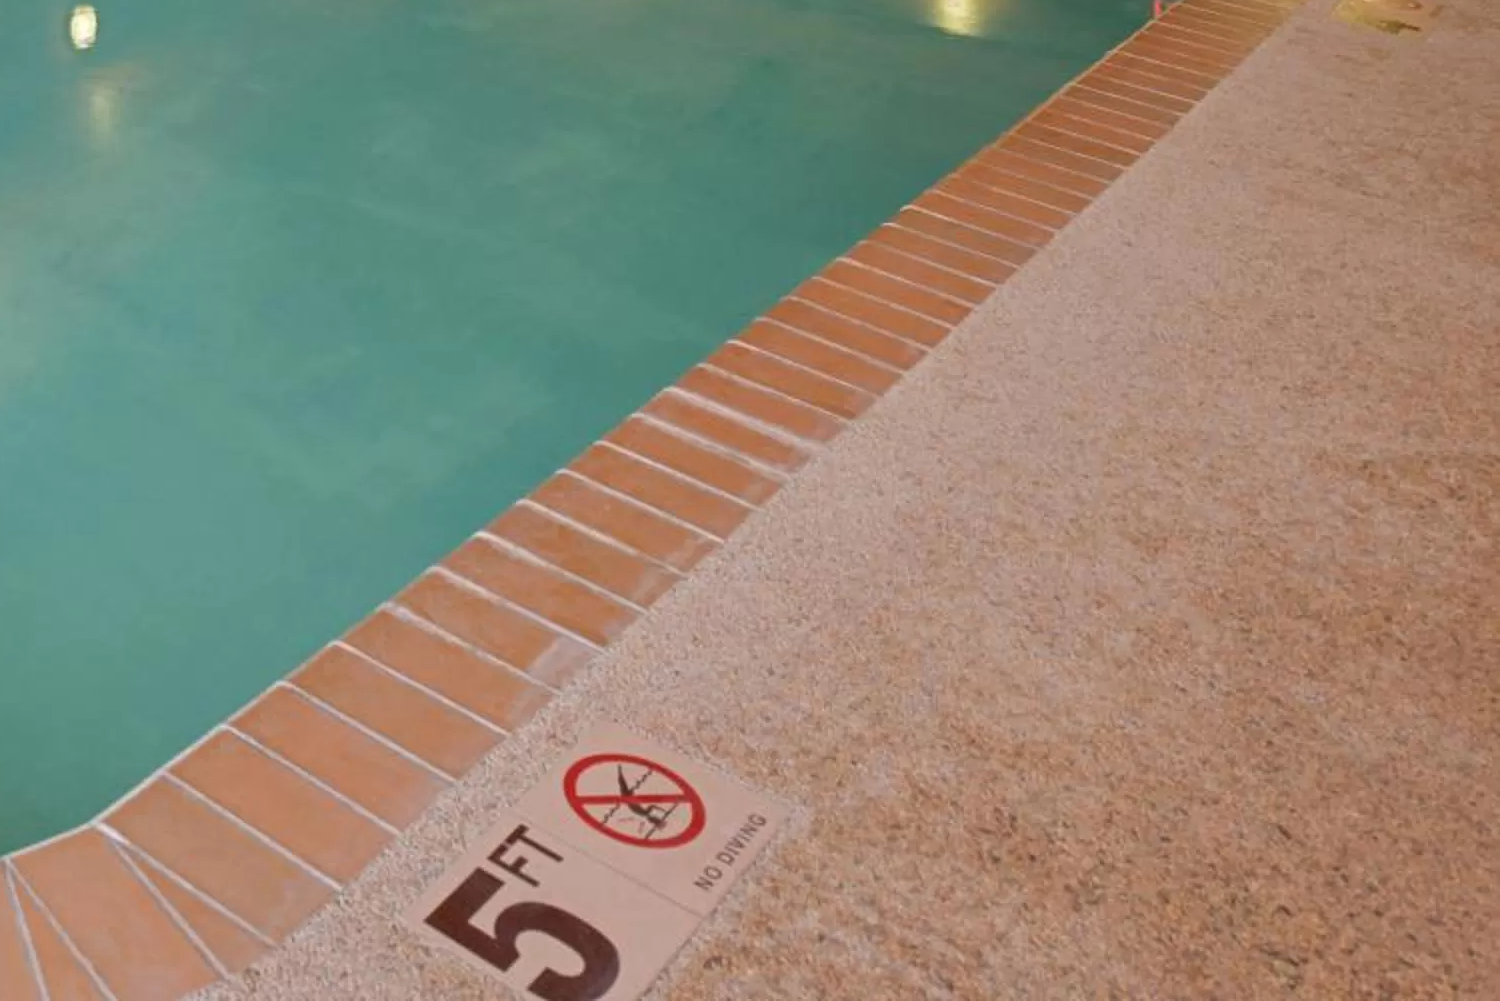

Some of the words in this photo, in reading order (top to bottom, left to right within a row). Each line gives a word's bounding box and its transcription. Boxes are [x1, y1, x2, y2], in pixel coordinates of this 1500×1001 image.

[487, 824, 564, 887] FT
[694, 867, 723, 892] NO
[719, 813, 768, 866] DIVING
[424, 866, 620, 1001] 5
